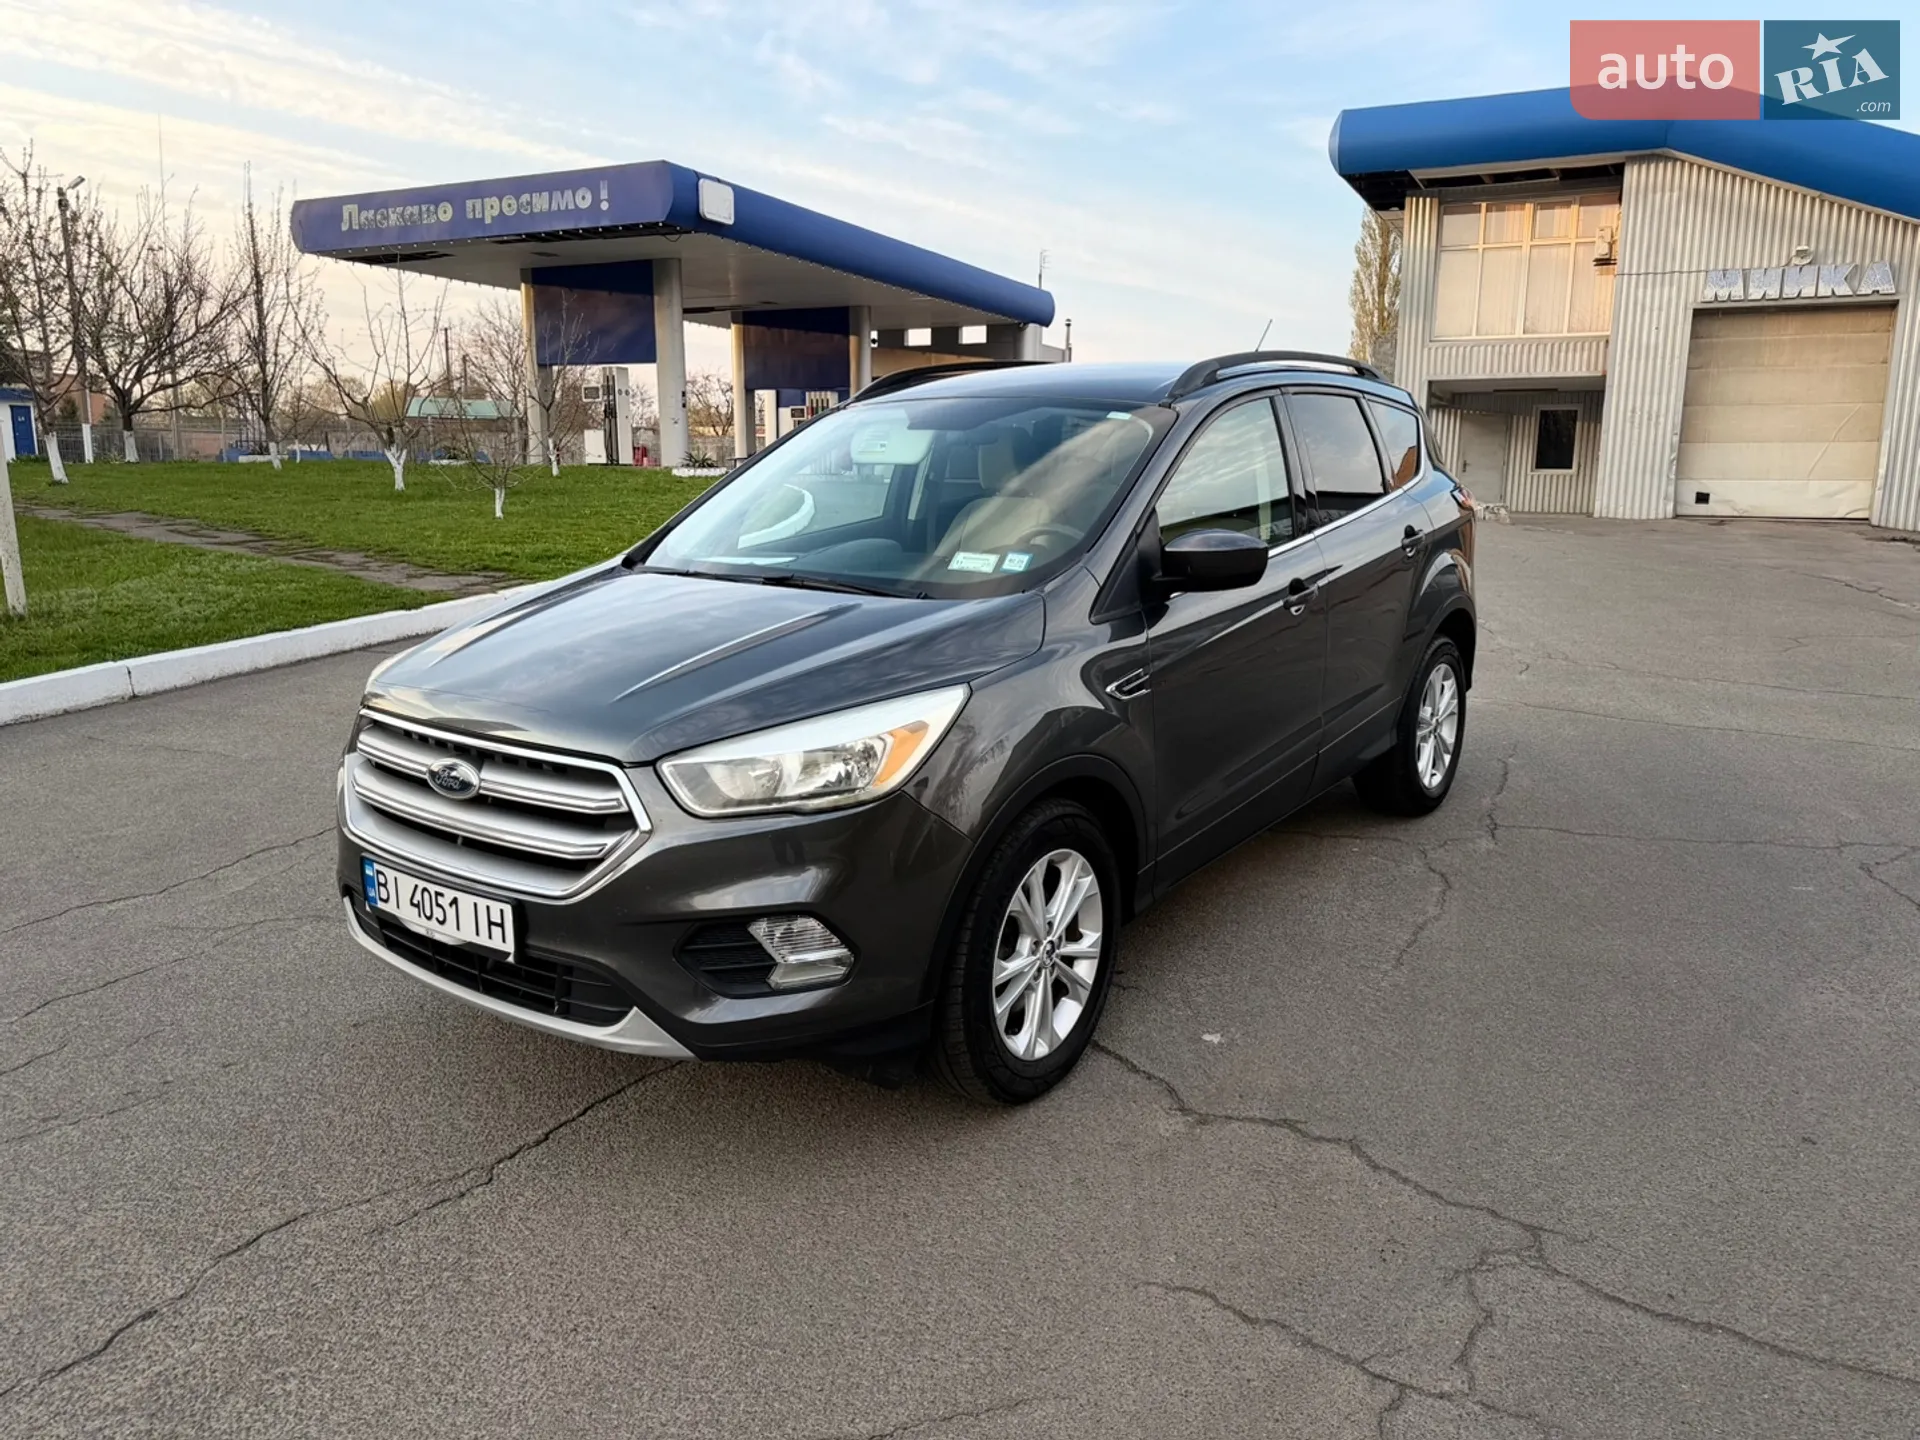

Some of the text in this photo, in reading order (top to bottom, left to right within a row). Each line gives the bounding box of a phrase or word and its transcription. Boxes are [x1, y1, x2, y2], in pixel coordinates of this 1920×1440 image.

[340, 201, 453, 232] Ласкаво
[375, 869, 507, 944] BI 4051 IH
